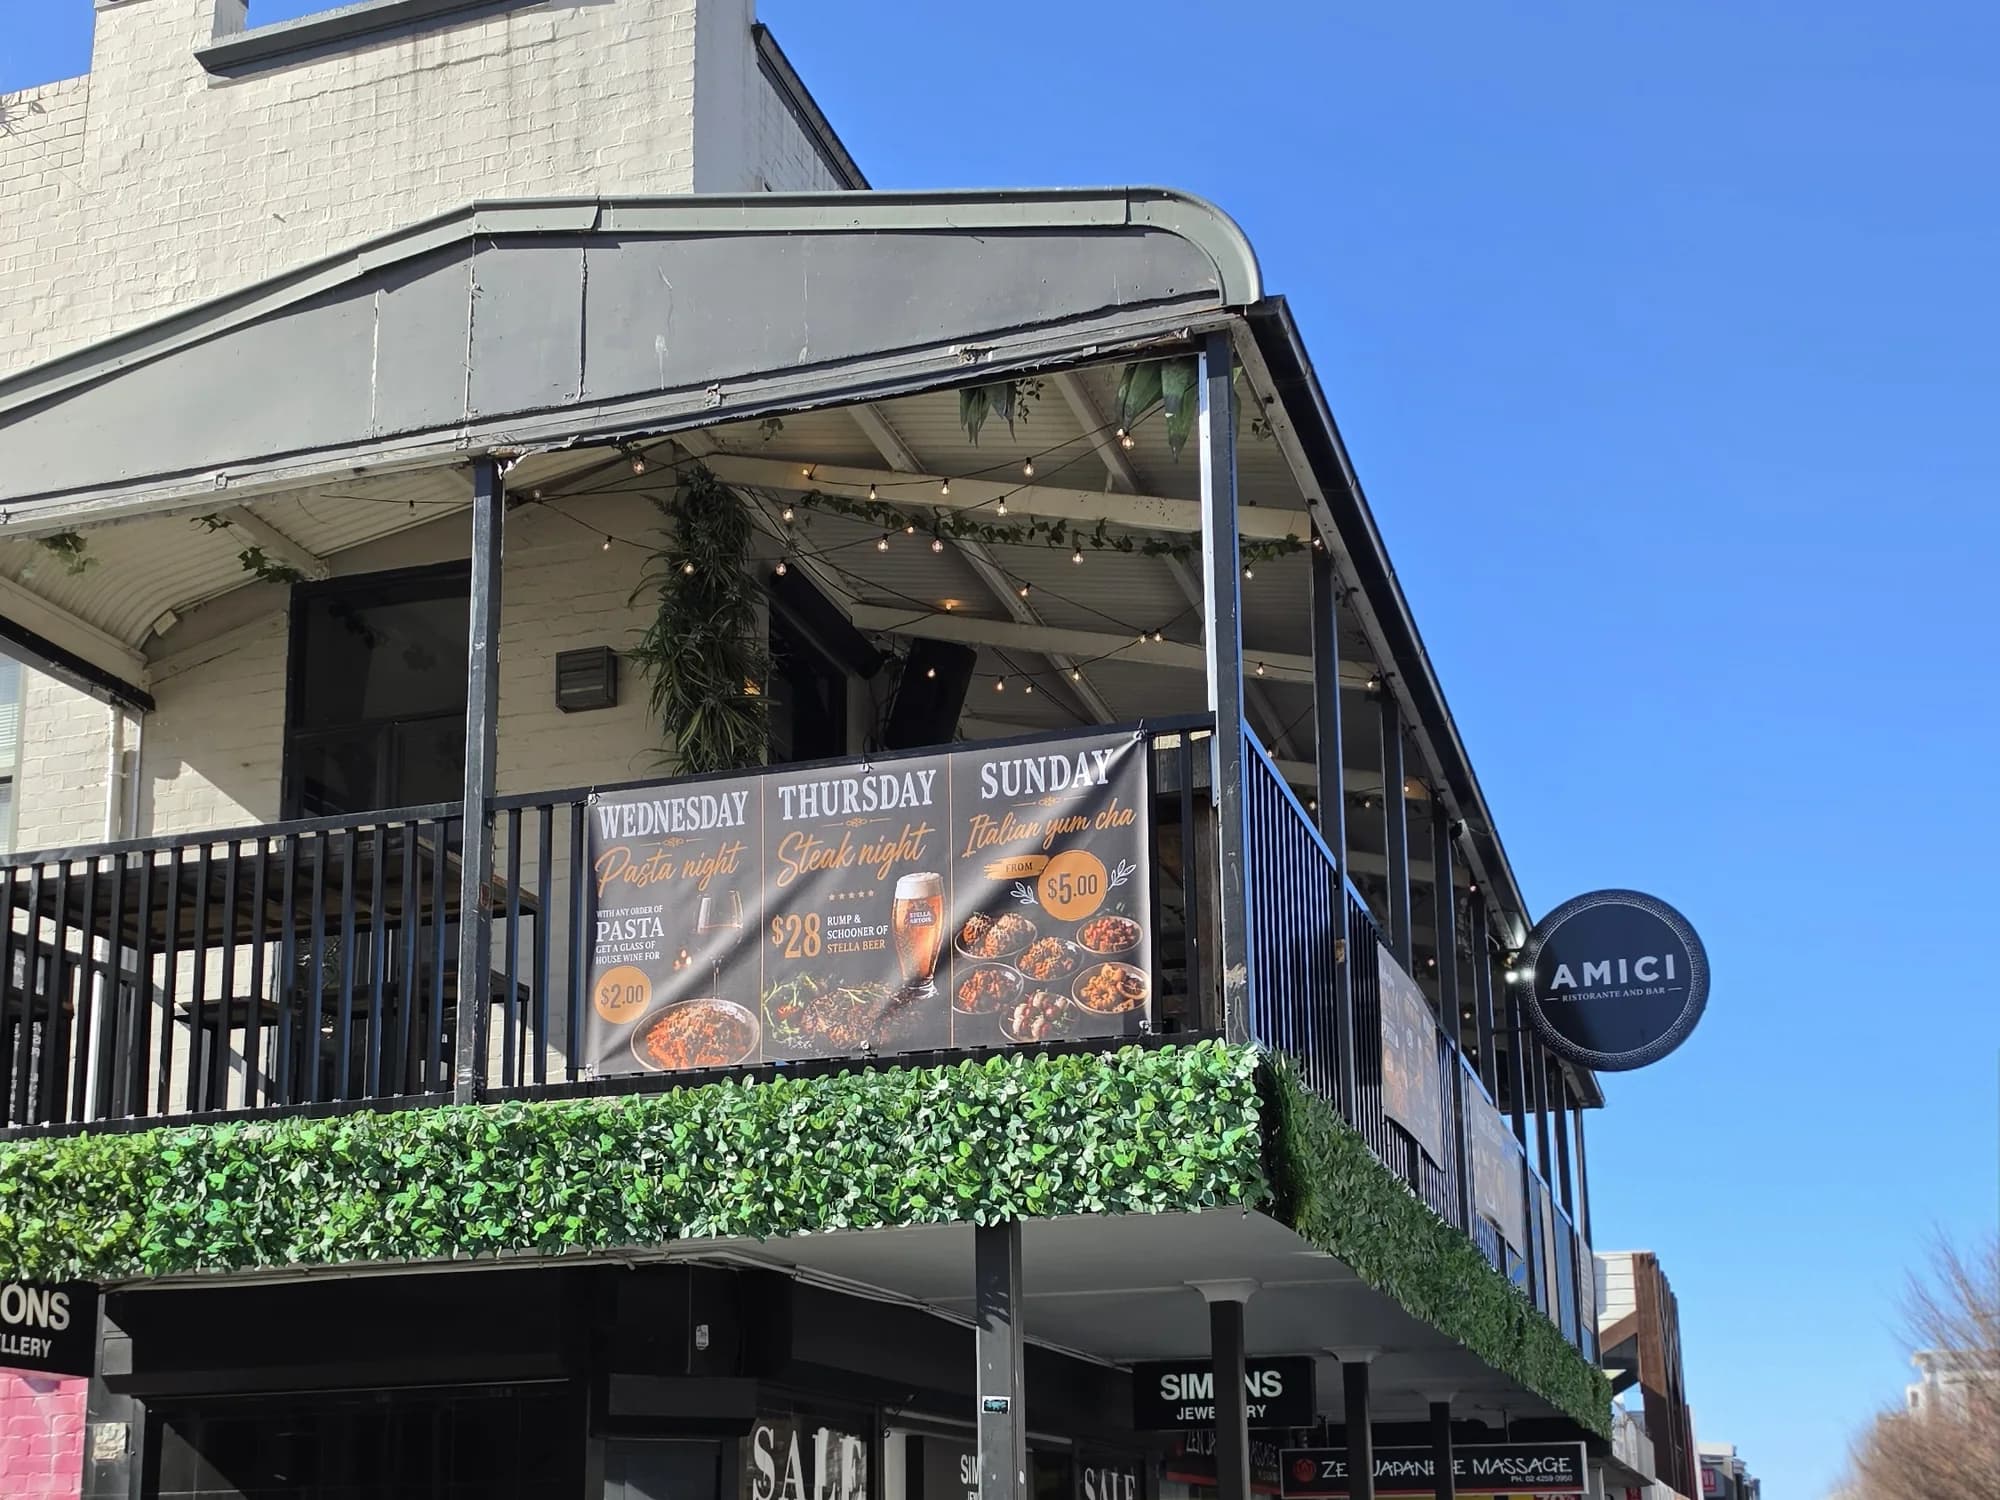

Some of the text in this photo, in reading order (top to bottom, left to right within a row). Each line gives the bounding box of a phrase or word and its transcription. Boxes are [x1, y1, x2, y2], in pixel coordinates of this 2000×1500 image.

[981, 749, 1113, 799] SUNDAY
[778, 769, 937, 820] THURSDAY
[597, 791, 749, 840] WEDNESDAY
[961, 798, 1137, 858] Italian yum cha
[776, 822, 936, 887] Steak night
[1005, 862, 1033, 873] FROM
[595, 841, 748, 897] Pasta night
[1047, 873, 1098, 905] $5.00
[596, 909, 615, 918] WITH
[616, 908, 630, 916] ANY
[631, 906, 653, 915] ORDER
[827, 914, 861, 926] RUMP &
[596, 916, 665, 943] PASTA
[772, 912, 821, 959] $28
[827, 925, 889, 940] SCHOONER OF
[596, 940, 656, 953] GET A GLASS OF
[596, 951, 660, 965] HOUSE WINE FOR
[827, 939, 886, 954] STELLA BEER
[1550, 954, 1675, 990] AMICI
[600, 983, 644, 1009] $2.00
[1562, 987, 1665, 1002] RISTORANTE AND BAR
[1, 1284, 70, 1331] ONS
[0, 1333, 52, 1358] LLERY
[1160, 1370, 1283, 1401] SIMNS
[1176, 1404, 1267, 1421] JEWERY
[1321, 1457, 1572, 1478] ZE JAPANE MASSAGE
